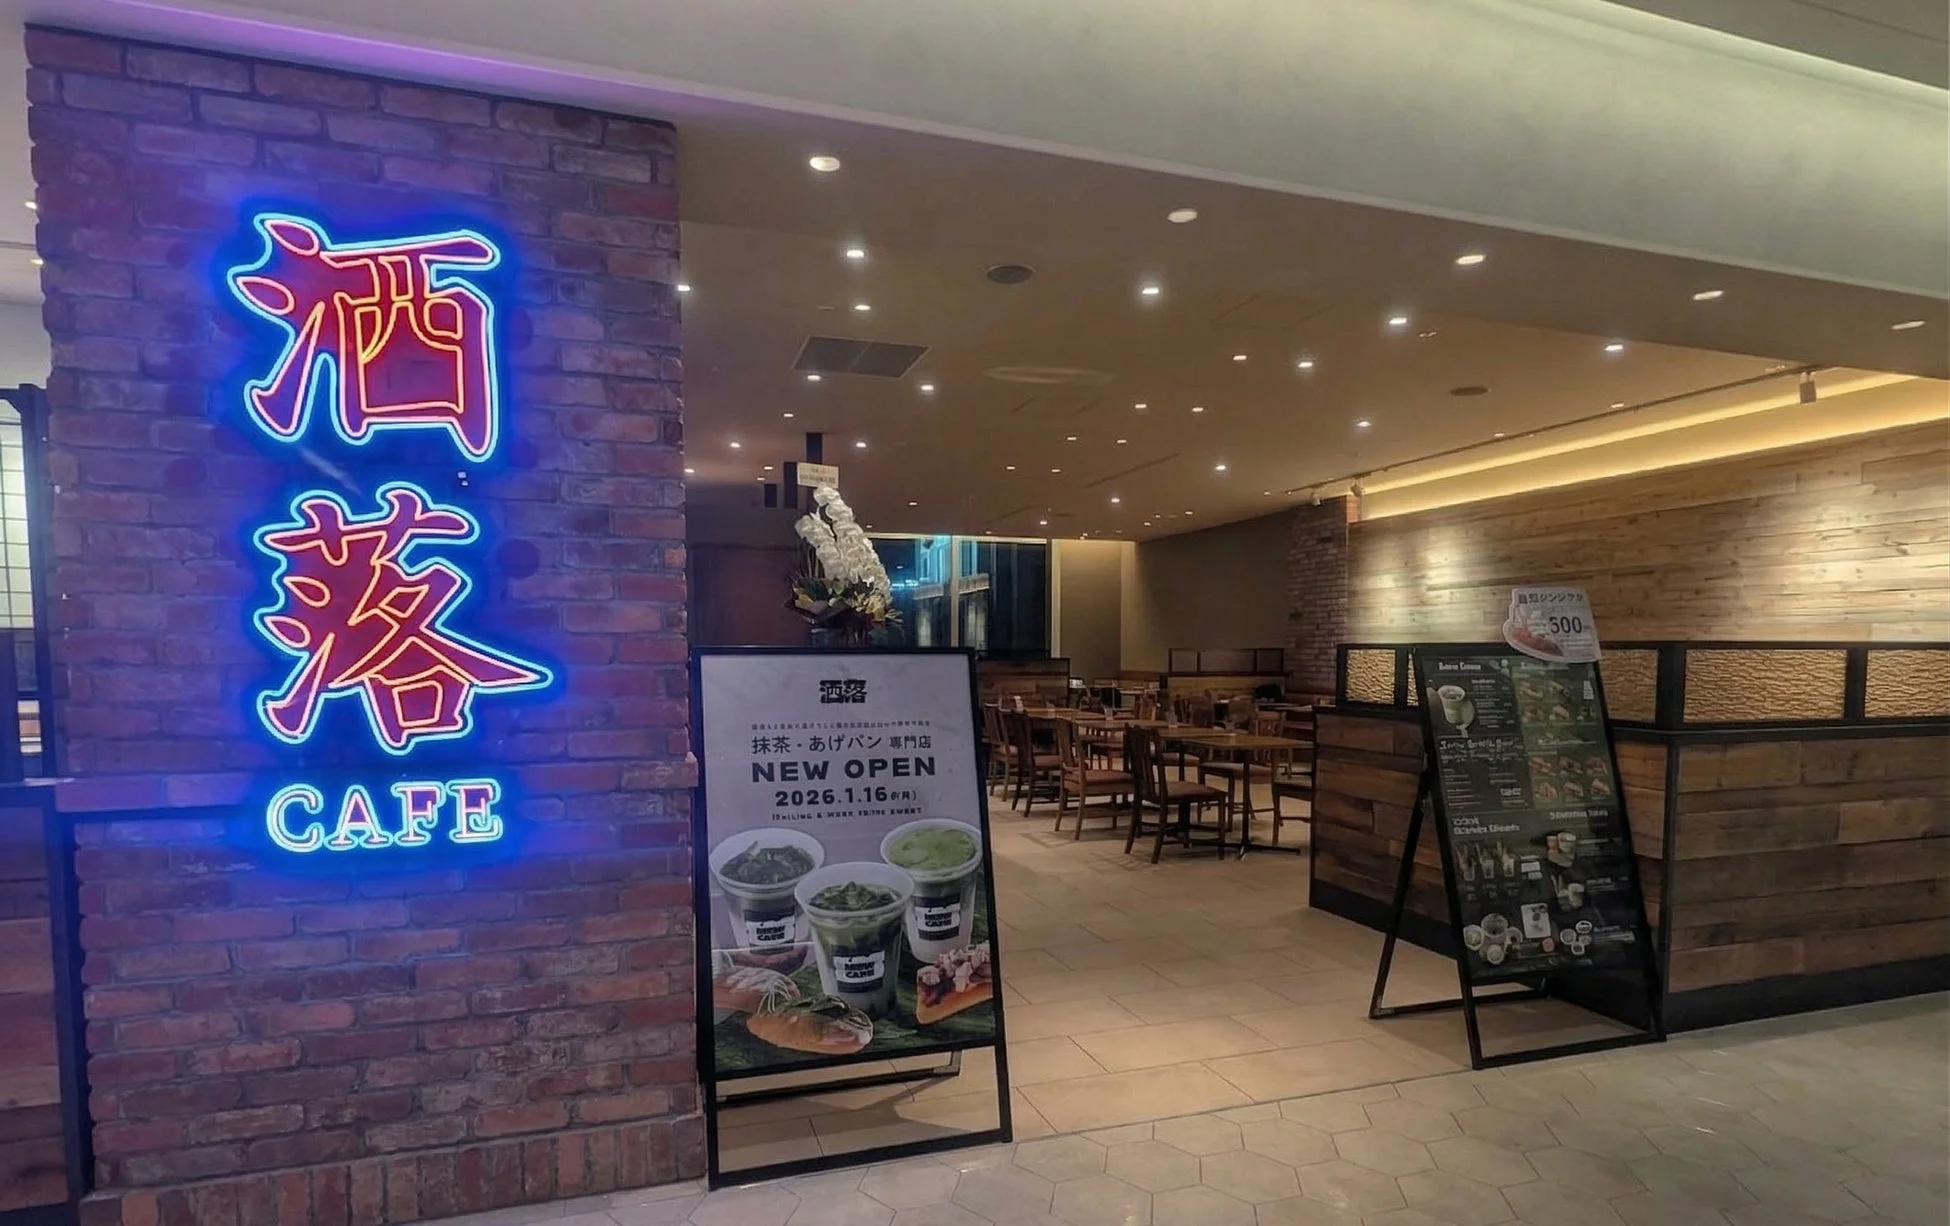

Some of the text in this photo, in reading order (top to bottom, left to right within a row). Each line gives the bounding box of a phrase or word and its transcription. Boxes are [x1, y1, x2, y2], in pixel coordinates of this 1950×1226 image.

[229, 213, 554, 755] 洒落
[752, 756, 936, 782] NEW OPEN
[267, 778, 503, 853] CAFE
